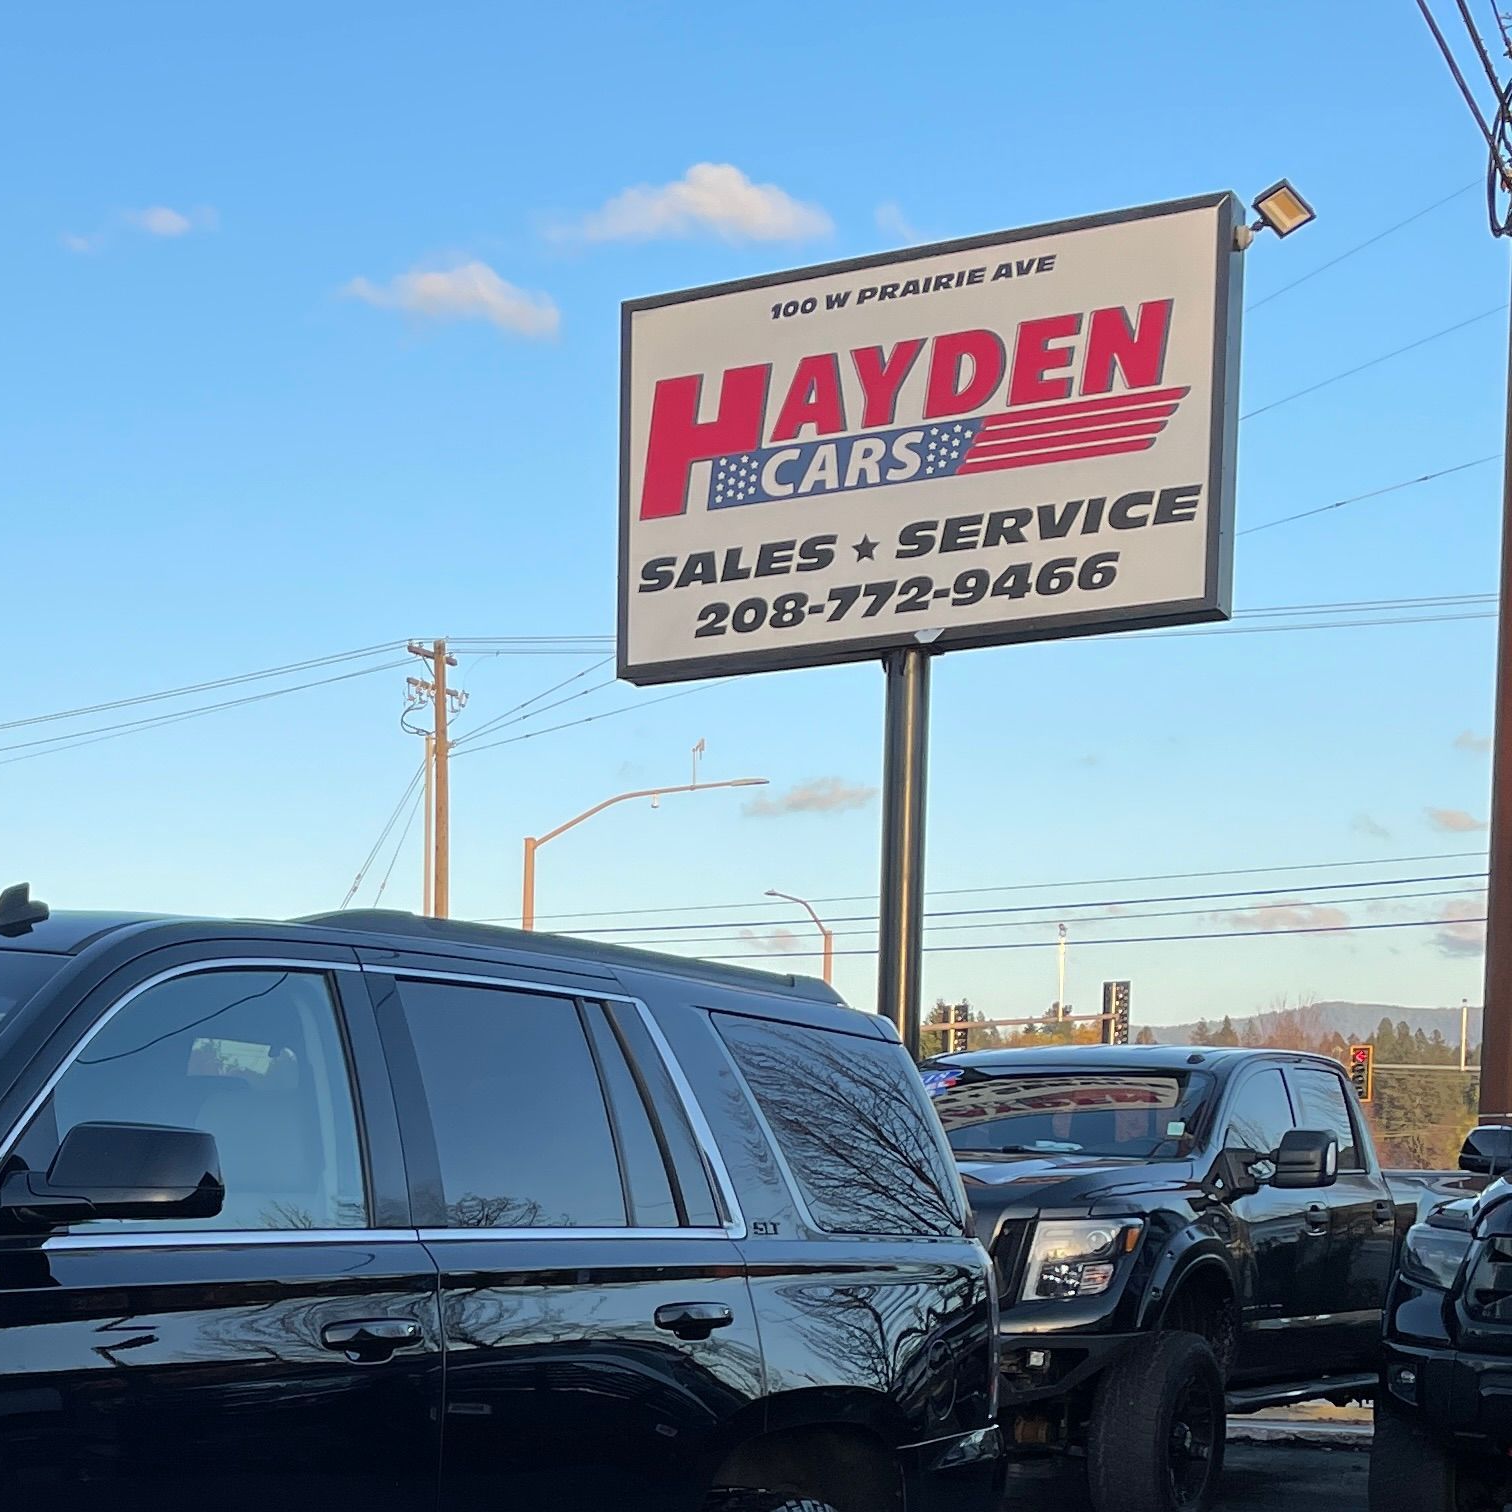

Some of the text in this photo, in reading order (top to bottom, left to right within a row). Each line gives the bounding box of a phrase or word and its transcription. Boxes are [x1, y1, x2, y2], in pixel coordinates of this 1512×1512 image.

[770, 254, 1057, 320] 100 W PRAIRIE AVE
[639, 298, 1175, 521] HAYDEN
[761, 431, 926, 498] CARS
[638, 484, 1203, 592] SALES SERVICE
[694, 552, 1120, 638] 208-772-9466
